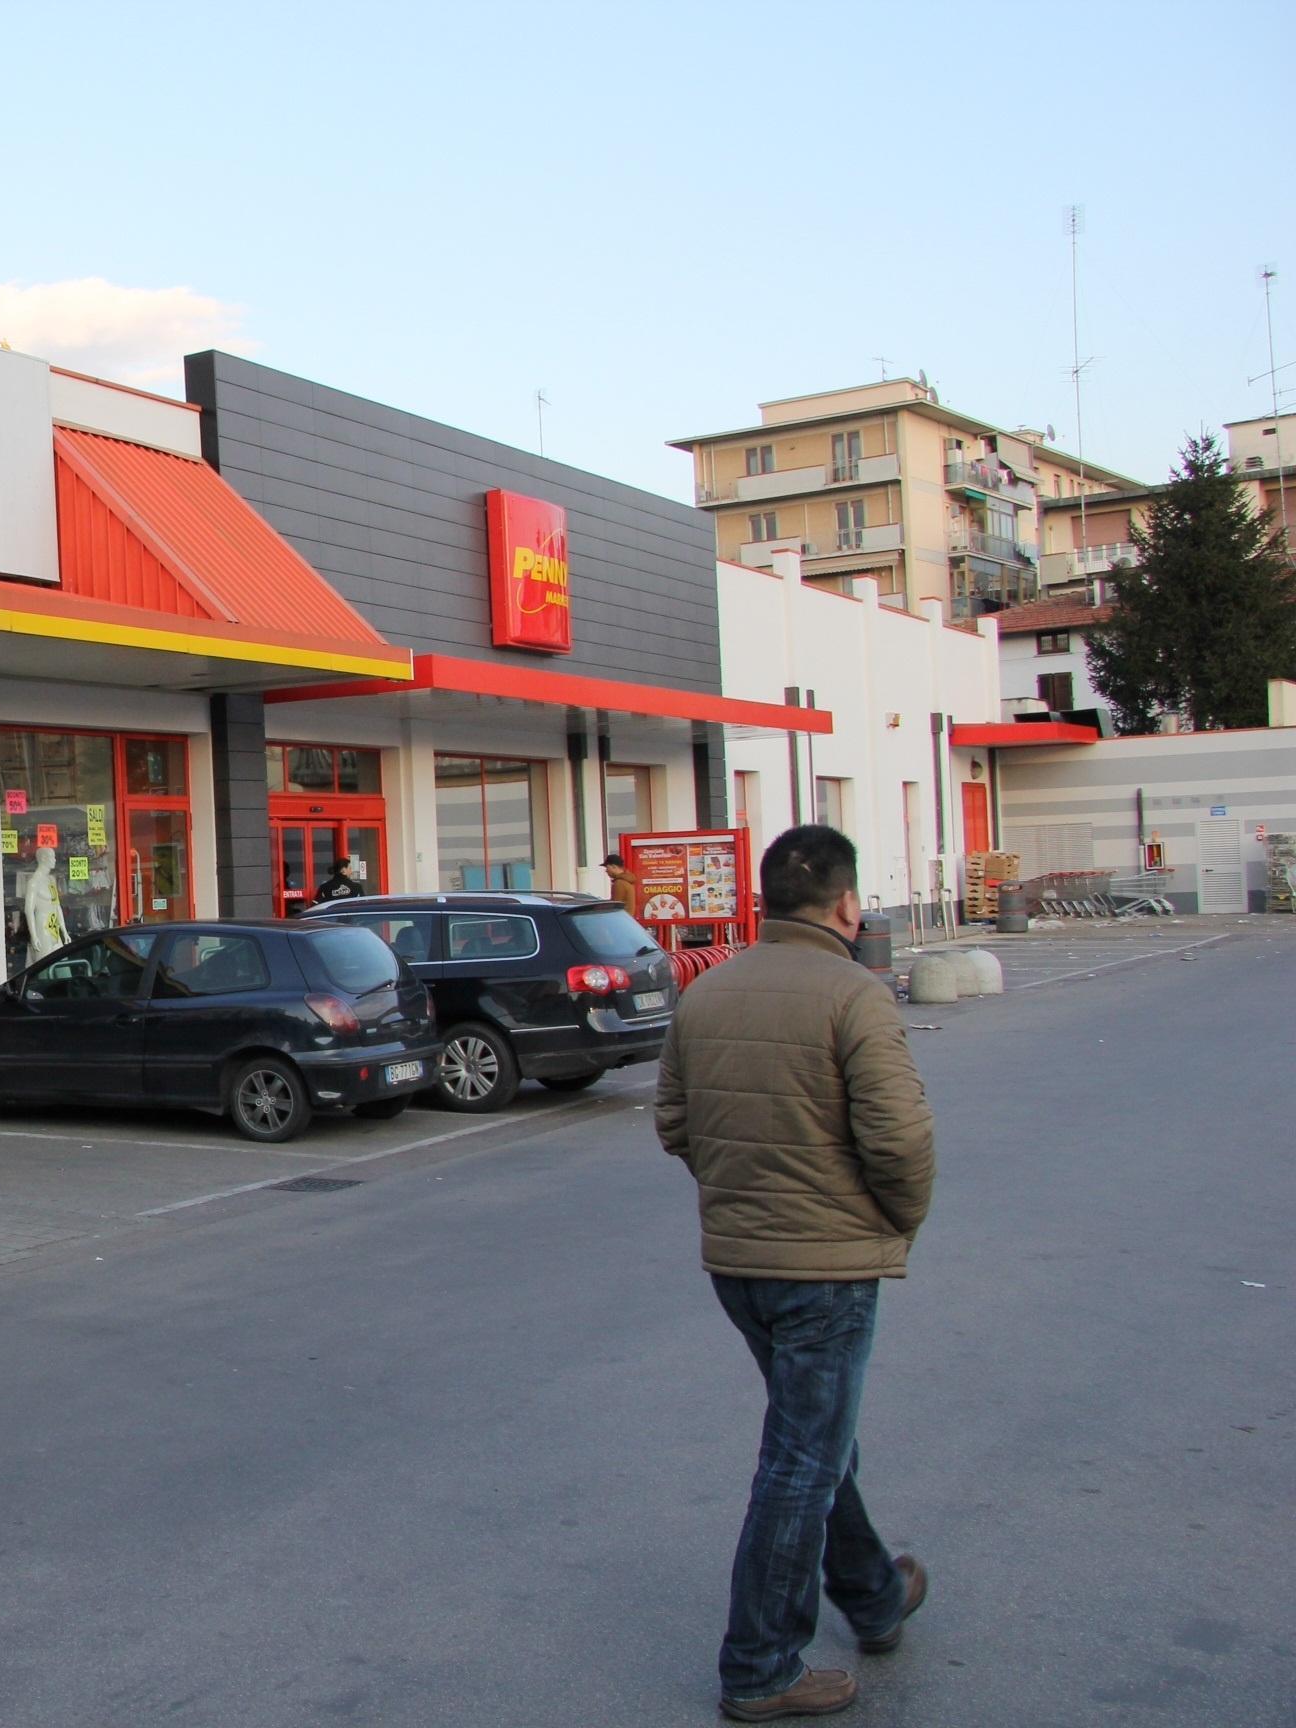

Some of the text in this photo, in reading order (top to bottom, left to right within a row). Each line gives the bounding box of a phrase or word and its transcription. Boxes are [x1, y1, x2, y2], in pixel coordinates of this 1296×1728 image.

[512, 546, 568, 588] PENNY
[71, 869, 87, 877] 20%
[283, 889, 304, 898] ENTRATA
[643, 885, 683, 895] OMAGGIO
